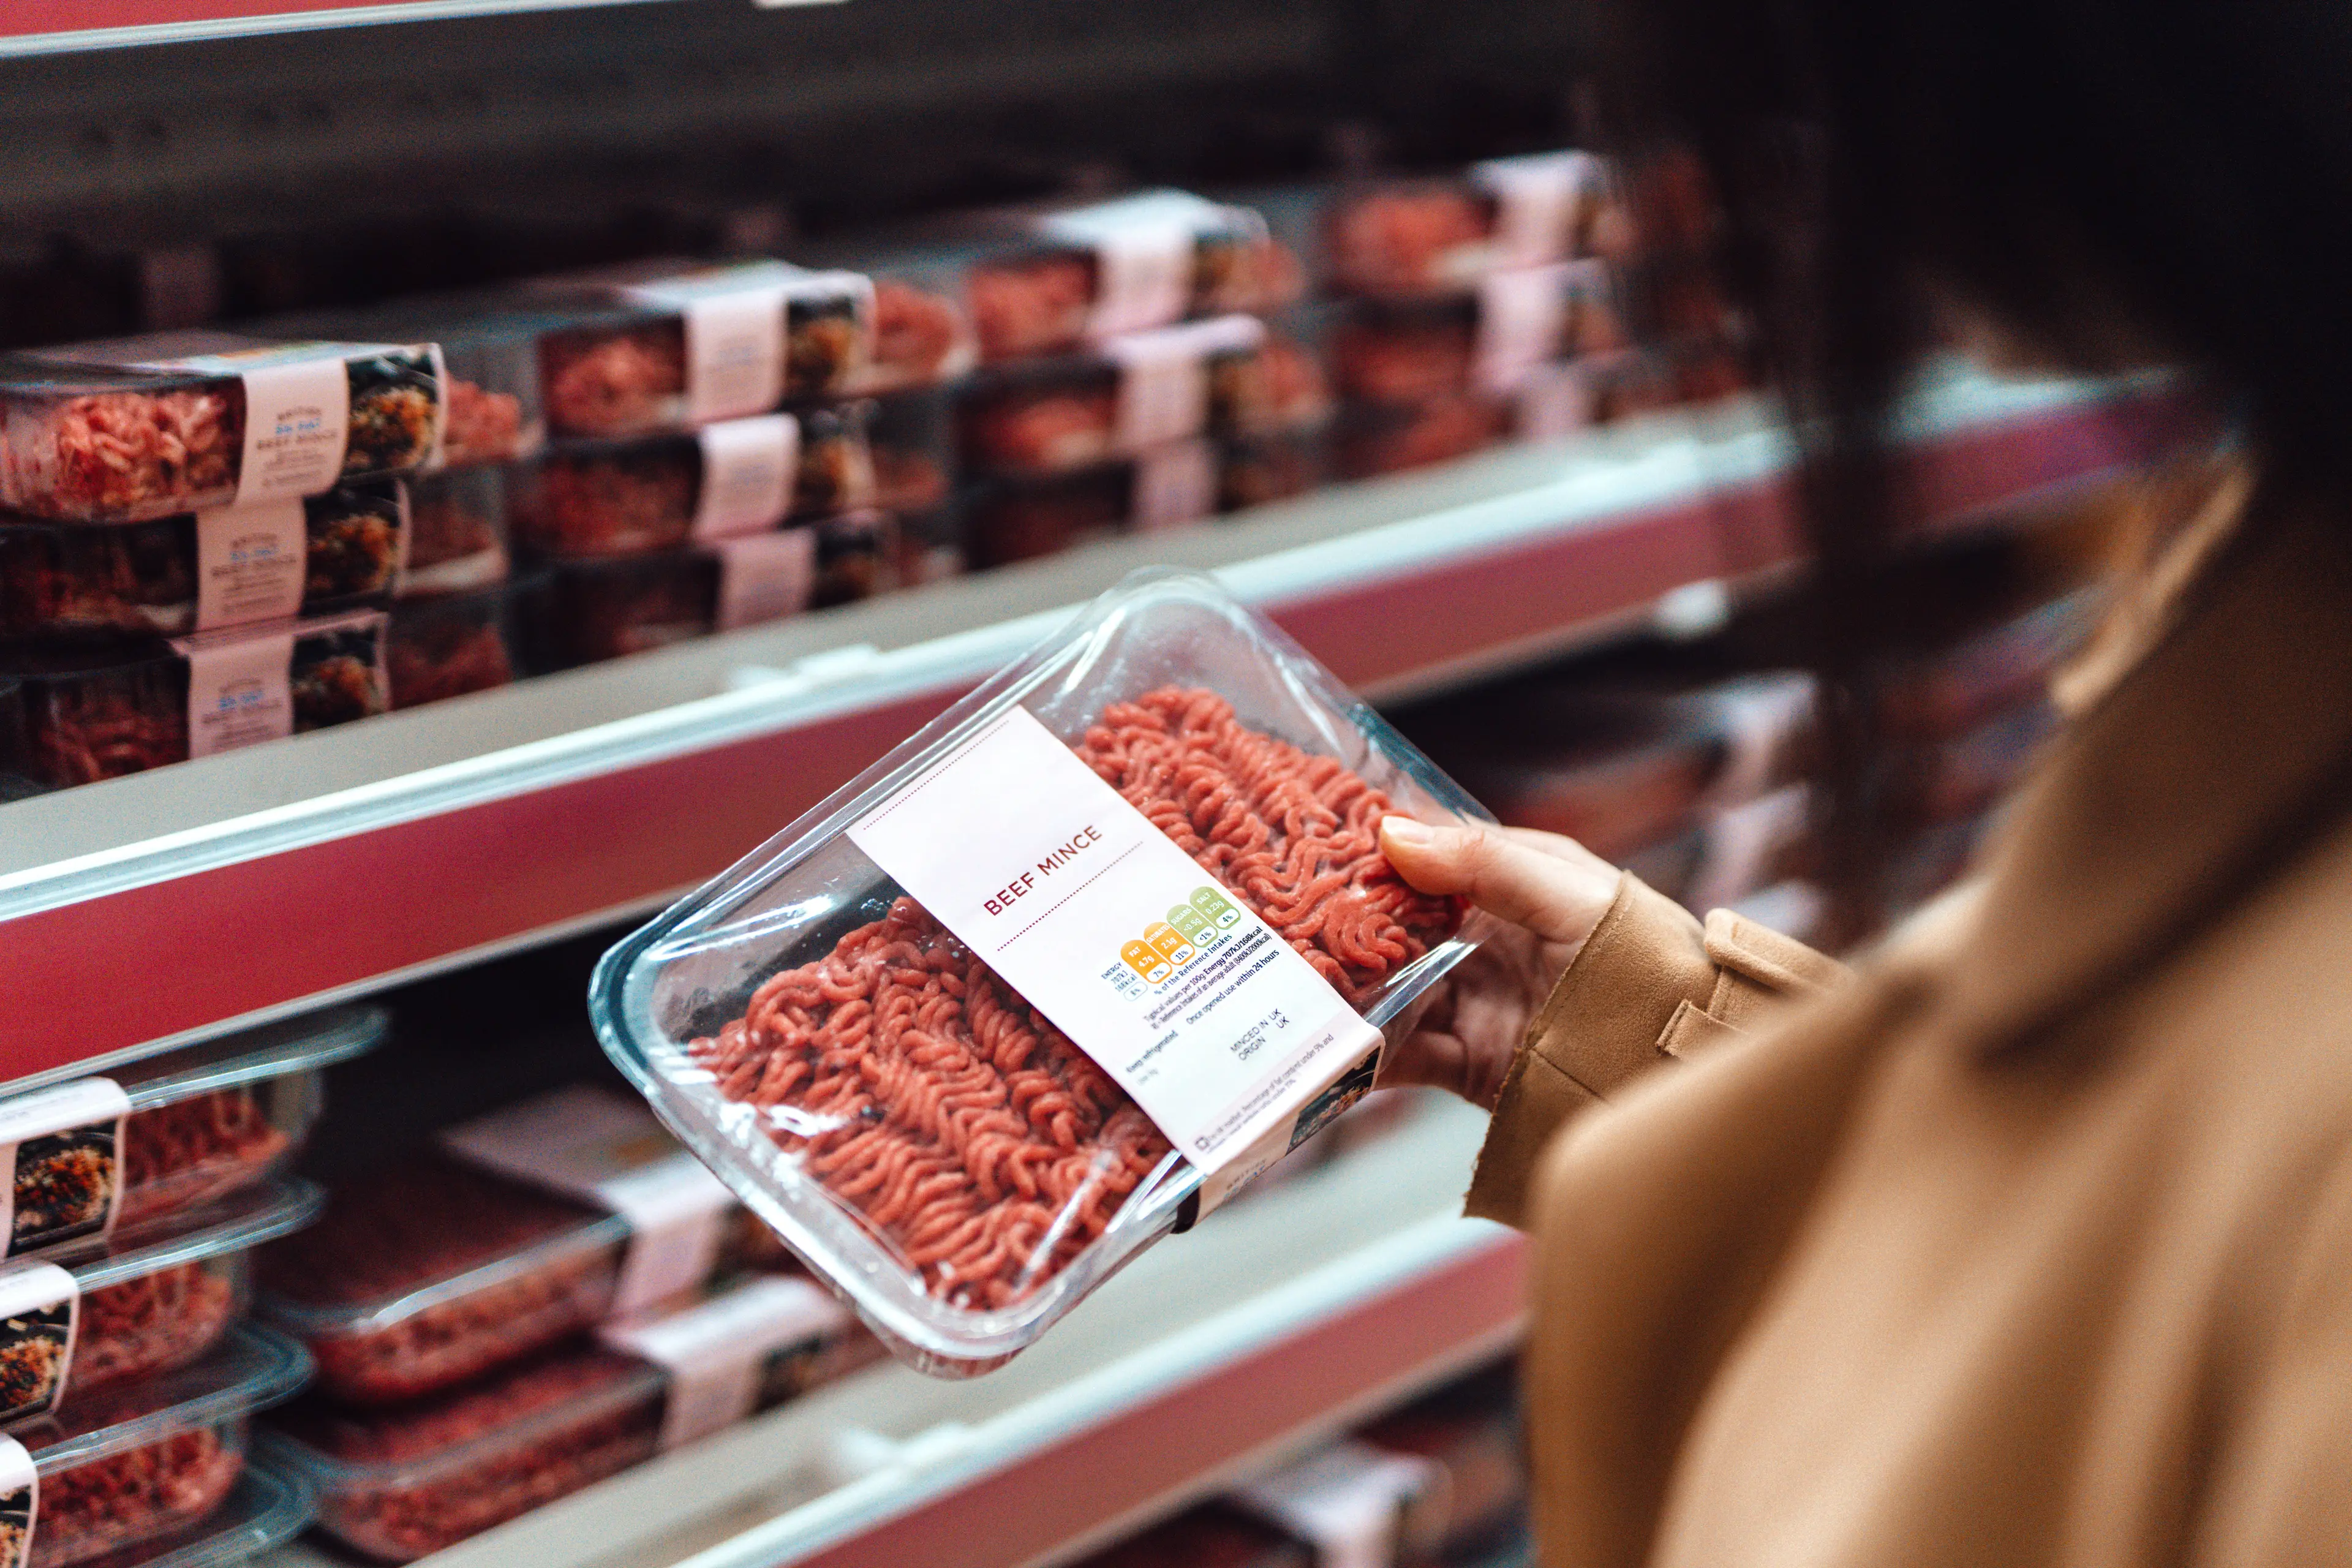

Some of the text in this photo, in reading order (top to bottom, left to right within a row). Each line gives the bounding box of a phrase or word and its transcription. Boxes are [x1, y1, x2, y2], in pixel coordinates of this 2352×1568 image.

[983, 825, 1102, 916] BEEF MINCE
[1196, 892, 1211, 905] SALT
[1205, 900, 1225, 914] 0.23g
[1170, 908, 1192, 925] SUGARS
[1183, 917, 1203, 931] <0.5g
[1146, 924, 1170, 943] SATURATES
[1199, 932, 1212, 940] <1%
[1128, 946, 1140, 957] FAT
[1161, 937, 1177, 949] 2.1g
[1138, 955, 1155, 967] 4.7g
[1161, 982, 1169, 991] of
[1167, 975, 1180, 986] the
[1178, 952, 1210, 977] Reference
[1207, 934, 1232, 954] Intakes
[1175, 950, 1189, 960] 11%
[1181, 983, 1192, 995] per
[1202, 957, 1226, 975] Energy
[1221, 925, 1263, 960] 707kJ/168kcal
[1101, 962, 1122, 979] ENERGY
[1196, 986, 1204, 995] of
[1207, 971, 1226, 987] average
[1223, 961, 1237, 974] adult
[1233, 933, 1272, 965] (8400kJ/2000kcal)
[1186, 949, 1280, 1025] Once opened use within 24 hours
[1230, 1008, 1282, 1052] MINCED IN UK
[1238, 1016, 1290, 1061] ORIGIN UK
[1300, 1049, 1316, 1064] under
[1322, 1033, 1334, 1046] and
